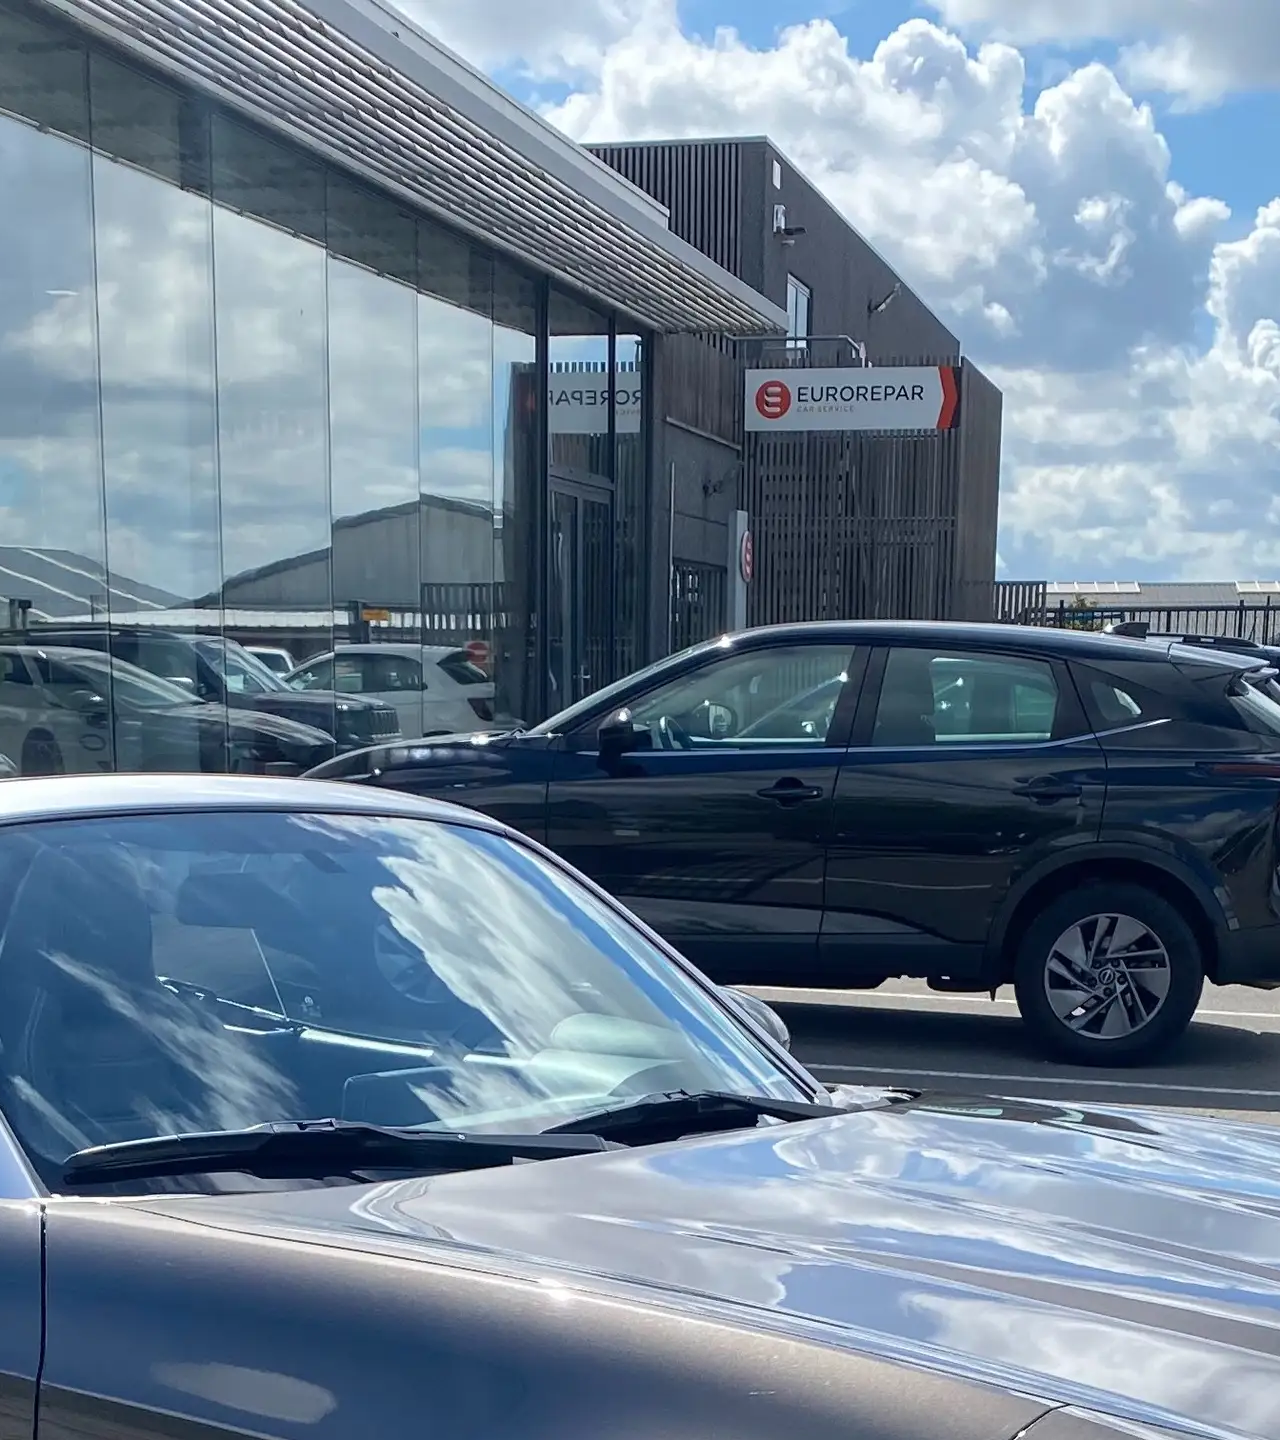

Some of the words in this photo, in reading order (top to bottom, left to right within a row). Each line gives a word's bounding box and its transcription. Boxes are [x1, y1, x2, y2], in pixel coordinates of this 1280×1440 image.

[797, 385, 924, 402] EUROREPAR
[796, 405, 814, 413] CAR
[817, 405, 855, 413] SERVICE
